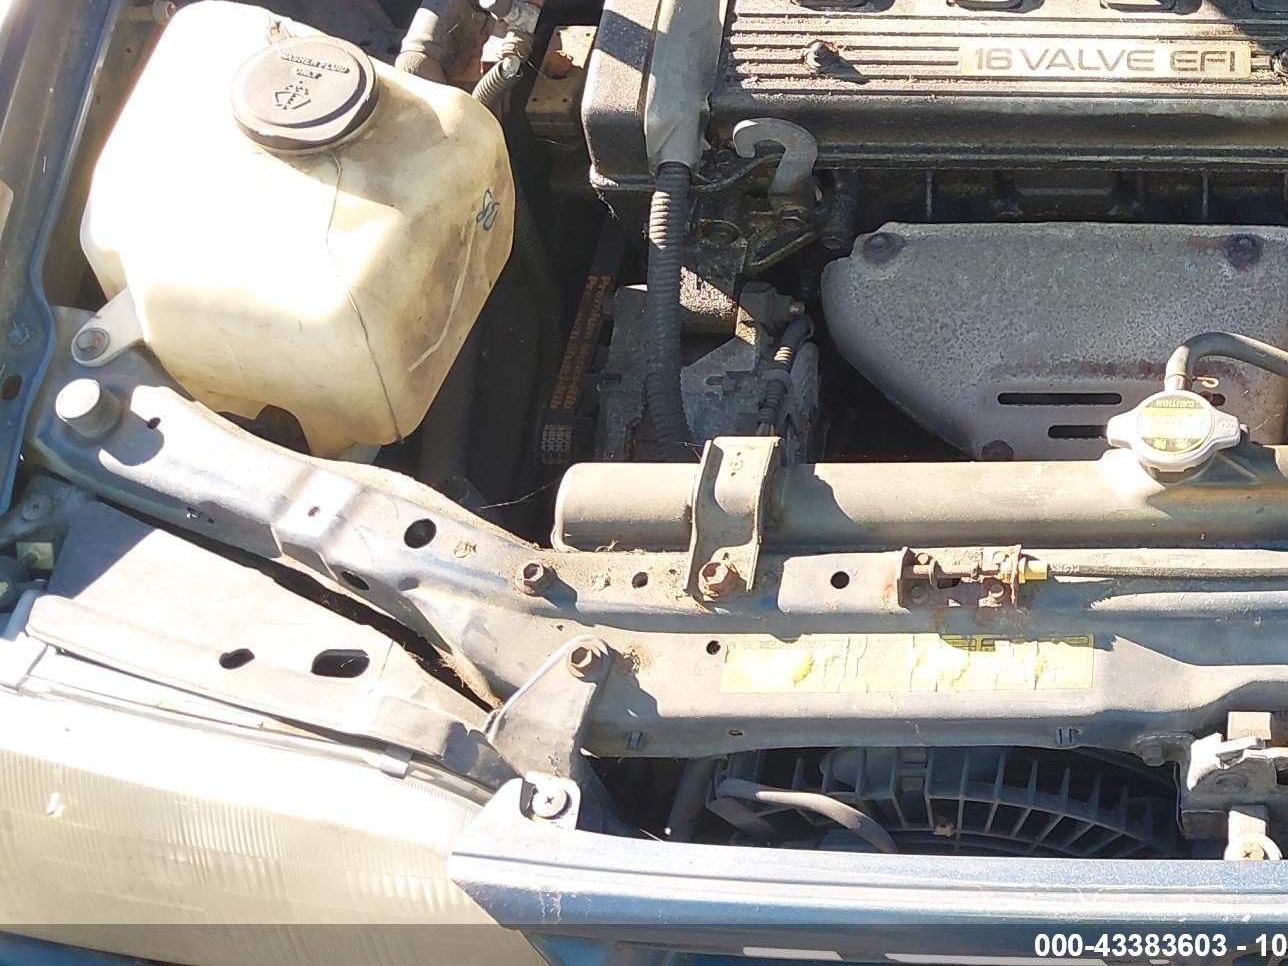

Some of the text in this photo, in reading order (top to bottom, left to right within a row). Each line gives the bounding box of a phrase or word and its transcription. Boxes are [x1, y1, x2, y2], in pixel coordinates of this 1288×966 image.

[975, 48, 1235, 72] 16 VALVE EFI
[1155, 399, 1195, 408] CAUTION
